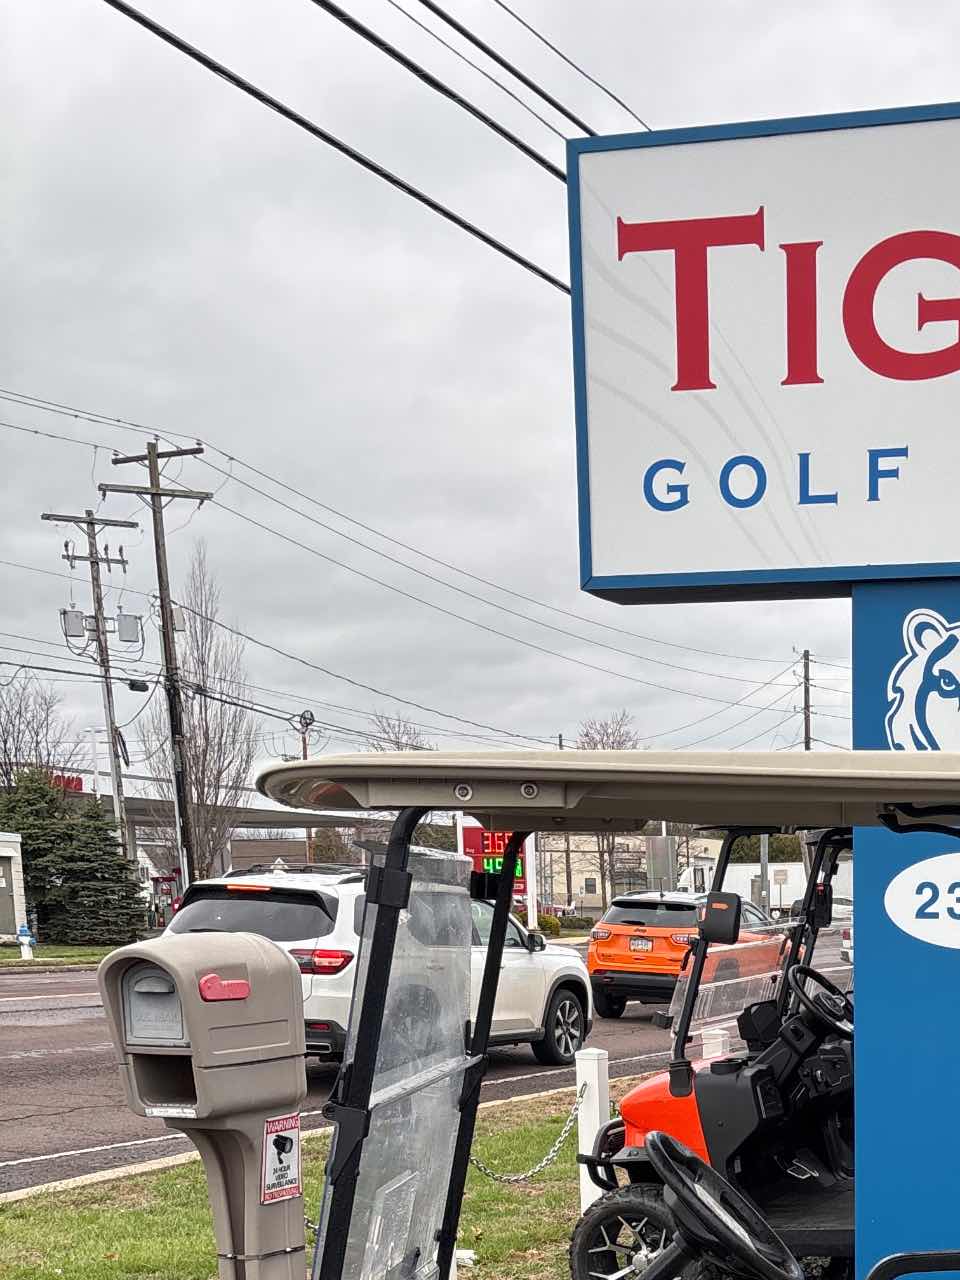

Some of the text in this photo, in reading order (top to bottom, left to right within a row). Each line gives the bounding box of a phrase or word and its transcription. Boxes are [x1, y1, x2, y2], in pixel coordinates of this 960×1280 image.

[643, 446, 910, 512] GOLF
[267, 1117, 299, 1133] WARNING
[275, 1172, 289, 1181] VIDEO
